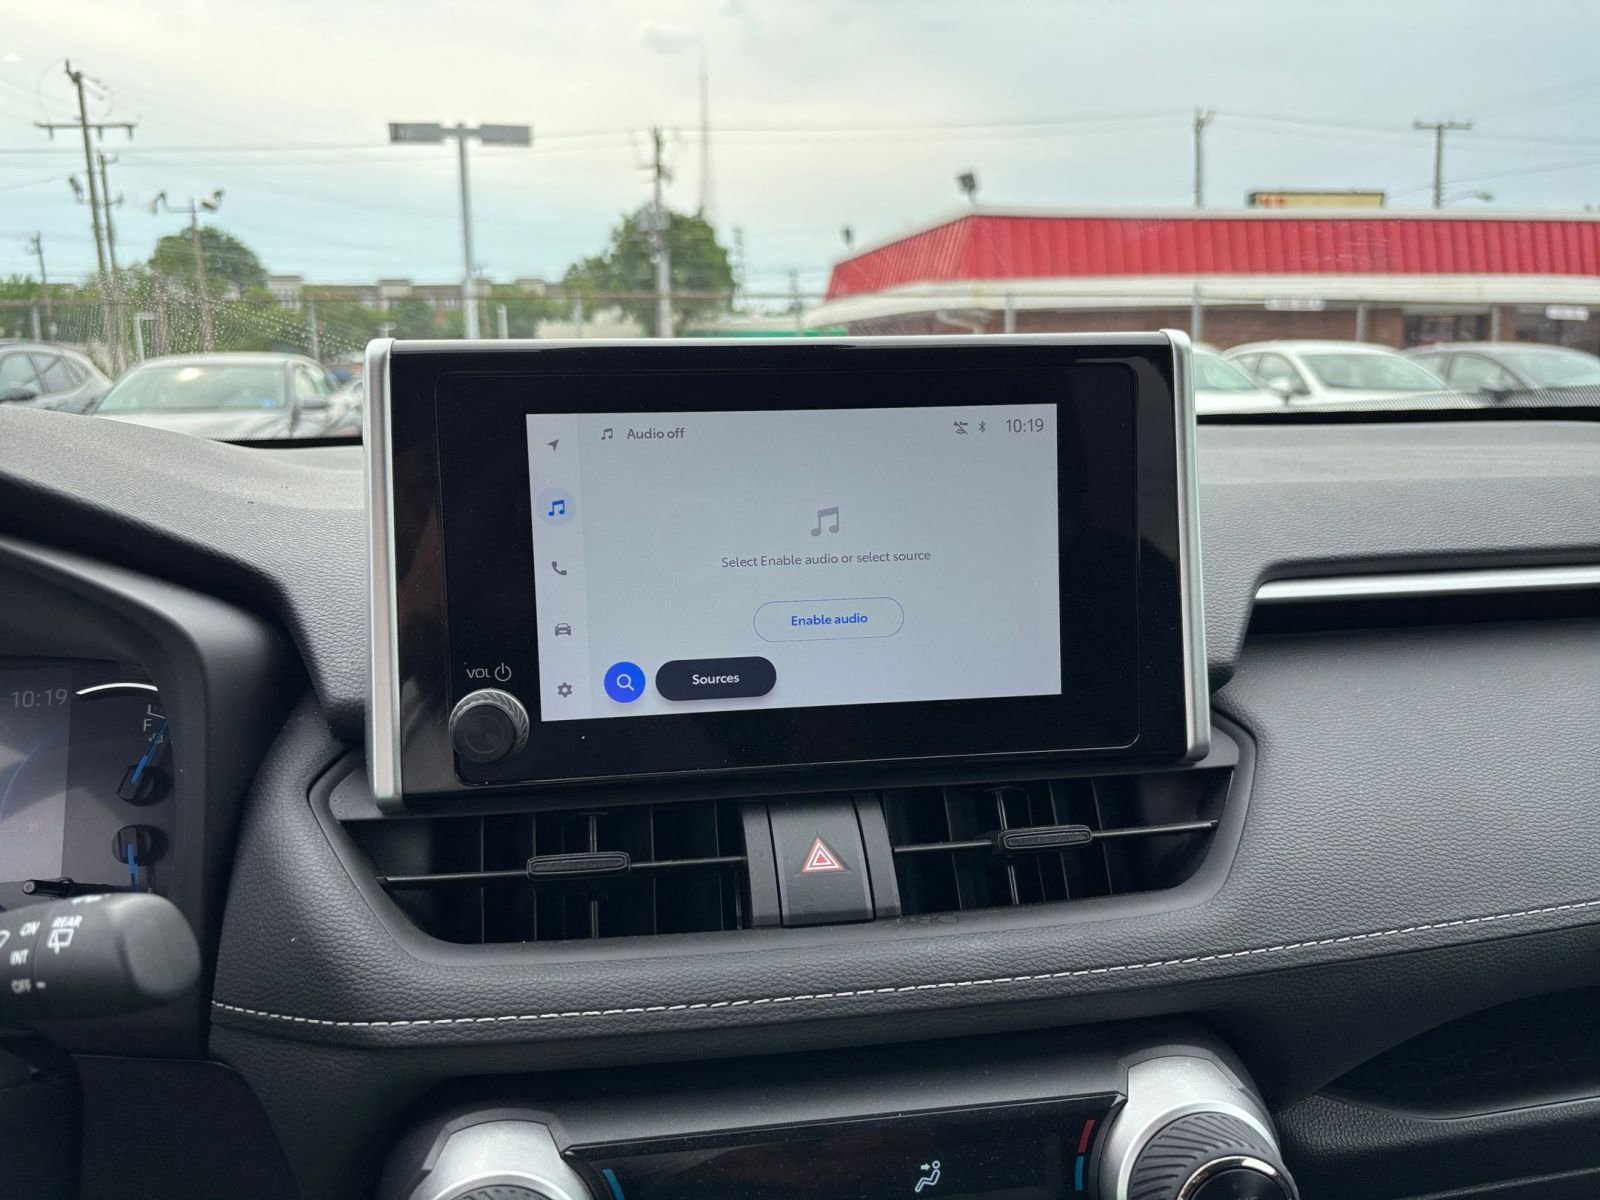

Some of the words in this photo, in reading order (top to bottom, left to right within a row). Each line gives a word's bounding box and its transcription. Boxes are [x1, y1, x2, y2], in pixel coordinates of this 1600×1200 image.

[1005, 418, 1045, 433] 10:19
[626, 427, 665, 440] Audio
[667, 427, 686, 439] off
[721, 556, 758, 568] Select
[760, 555, 802, 567] Enable
[805, 553, 839, 565] audio
[841, 554, 854, 564] or
[856, 552, 890, 563] select
[893, 551, 931, 561] source
[791, 614, 832, 626] Enable
[834, 612, 868, 625] audio
[466, 666, 491, 679] VOL
[692, 672, 740, 686] Sources
[11, 688, 68, 708] 10:19
[19, 920, 41, 937] ON
[51, 915, 82, 929] REAR
[9, 949, 29, 966] INT
